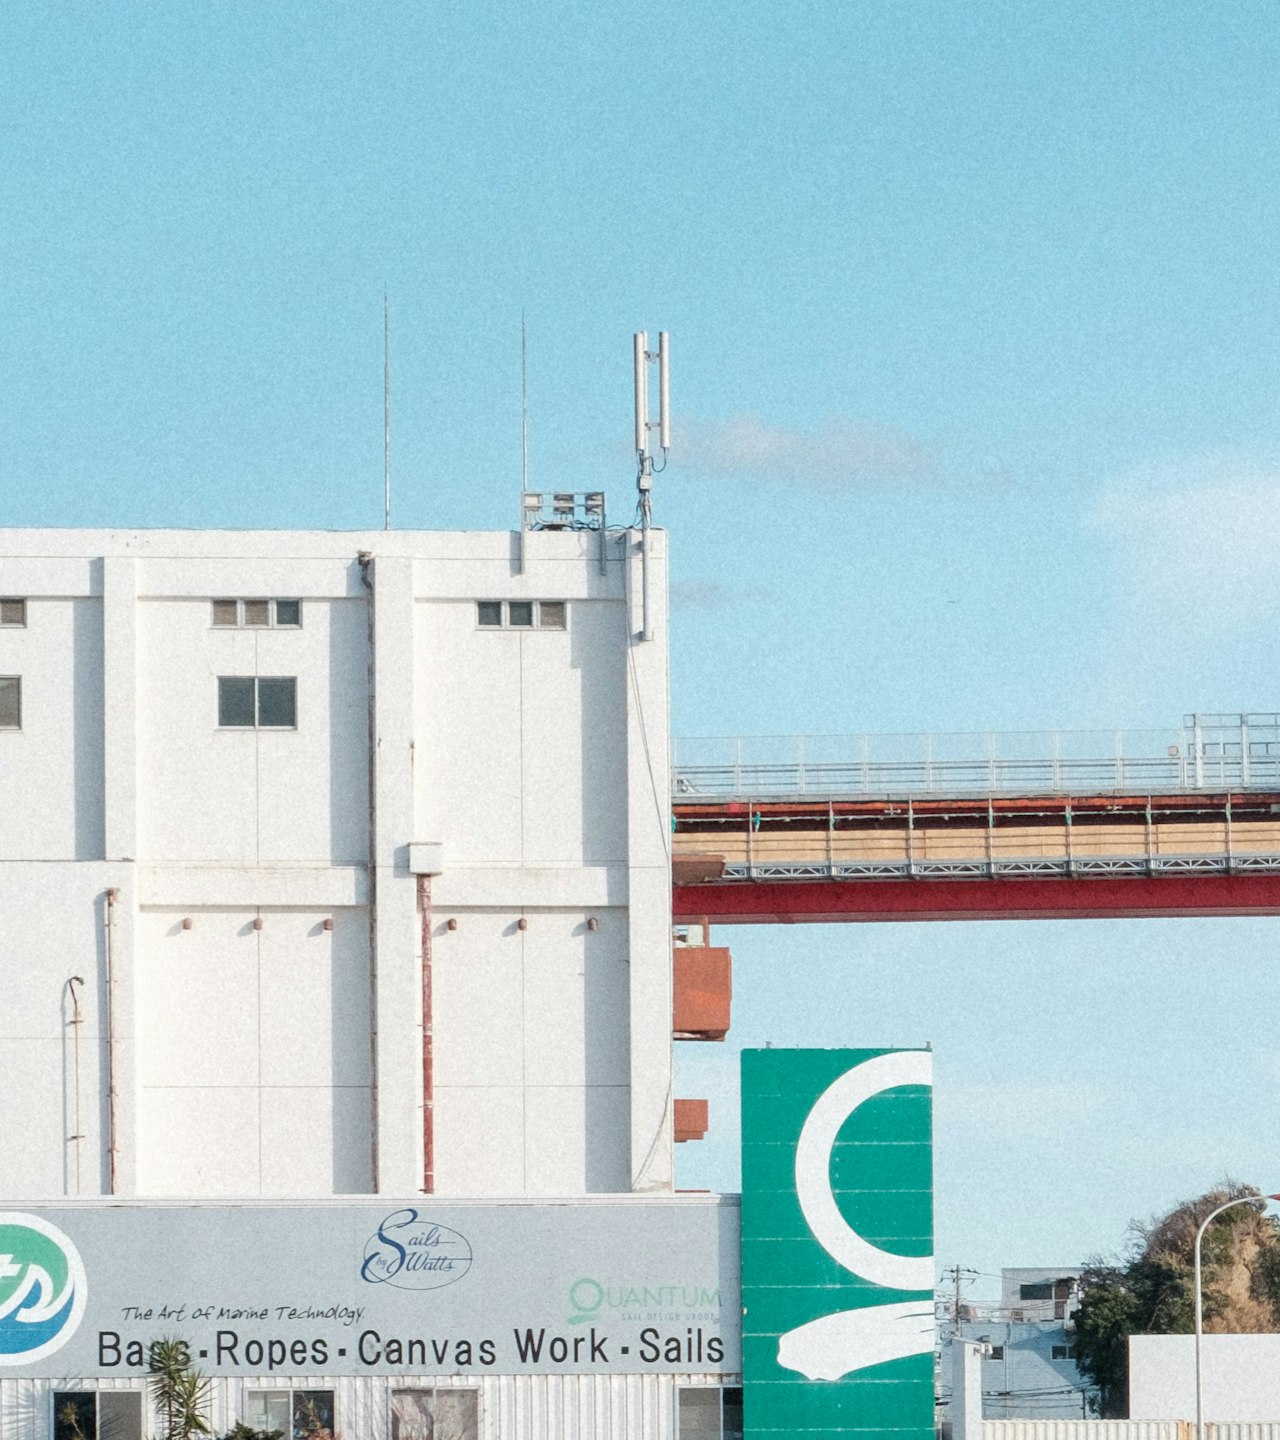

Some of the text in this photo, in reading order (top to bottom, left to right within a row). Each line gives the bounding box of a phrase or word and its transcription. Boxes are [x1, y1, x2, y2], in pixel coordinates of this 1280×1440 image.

[405, 1250, 456, 1273] Watts
[121, 1306, 152, 1321] The
[158, 1304, 184, 1323] Art
[216, 1307, 269, 1321] Marine
[567, 1278, 722, 1325] QUANTUM
[216, 1330, 328, 1370] Ropes
[358, 1329, 497, 1366] Canvas
[513, 1328, 609, 1364] Work
[639, 1327, 724, 1363] Sails
